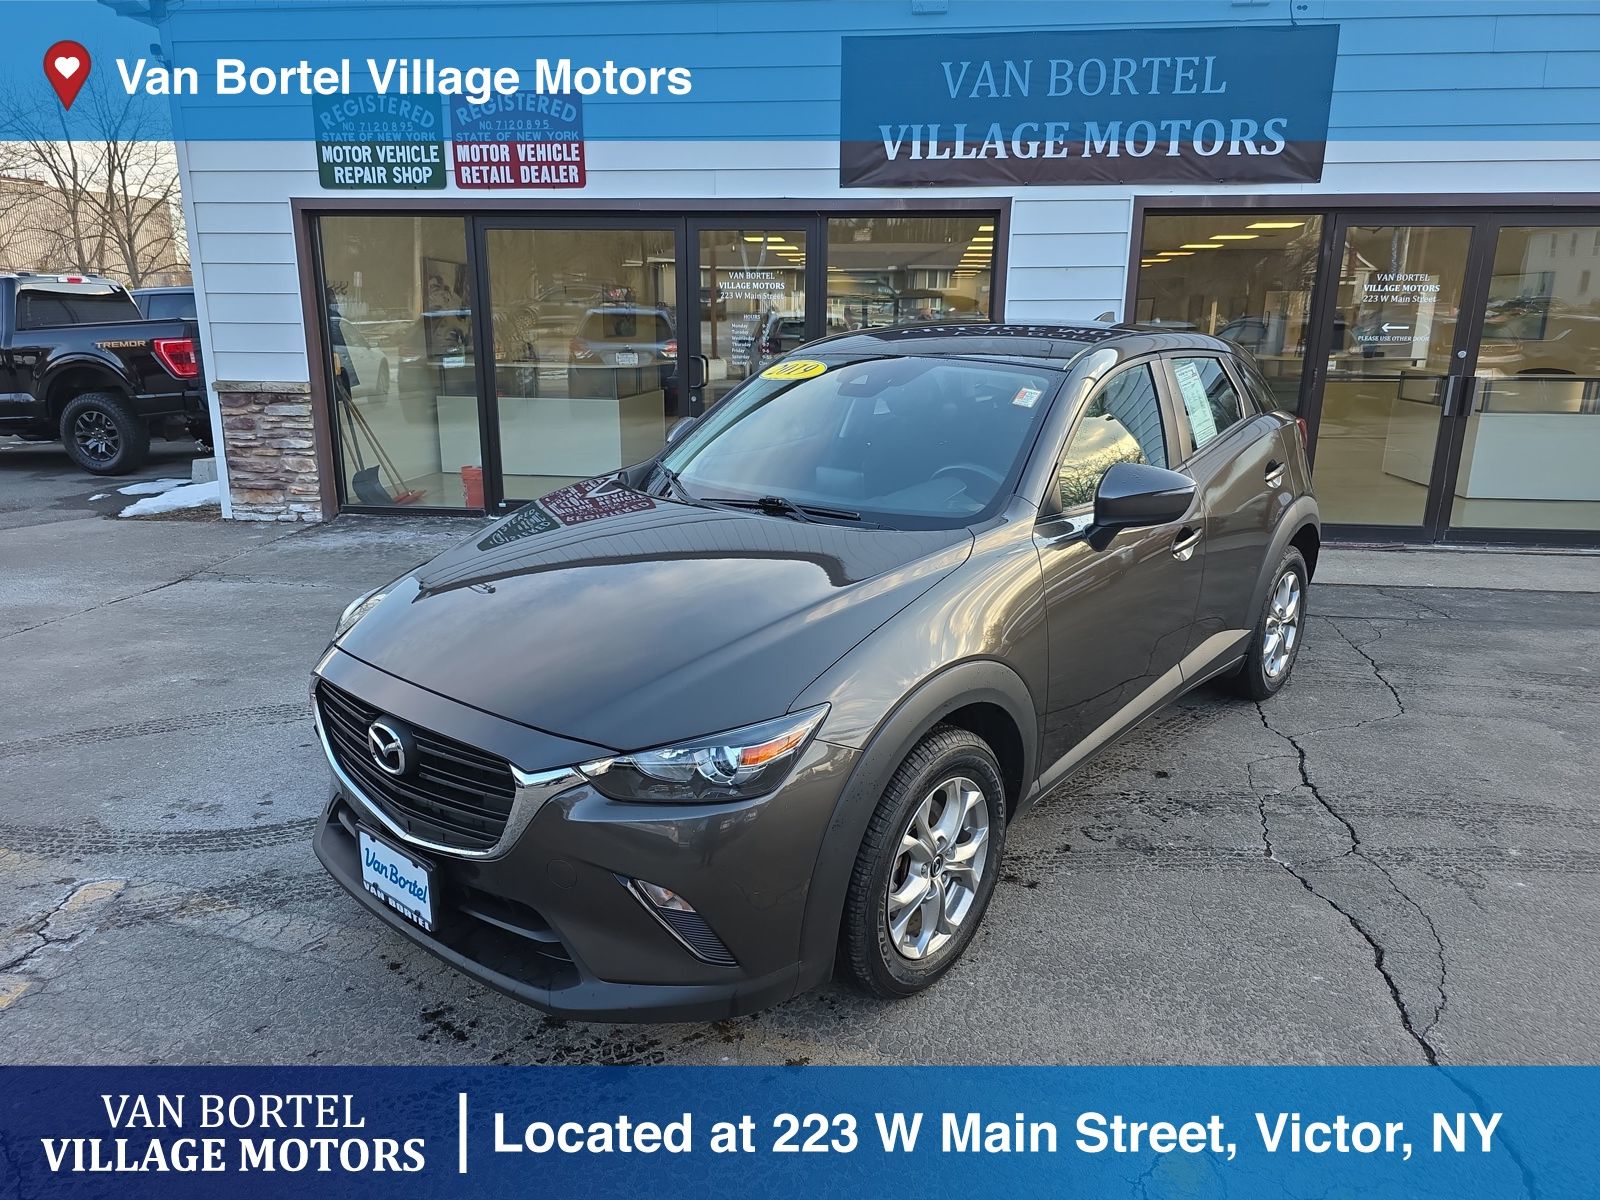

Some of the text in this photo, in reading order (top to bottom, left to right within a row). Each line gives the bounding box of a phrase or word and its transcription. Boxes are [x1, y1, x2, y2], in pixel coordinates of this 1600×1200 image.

[941, 55, 1227, 98] VAN BORTEL
[320, 94, 435, 130] REGISTERED
[456, 93, 577, 126] REGISTERED
[360, 121, 413, 132] 7120895
[496, 120, 550, 130] 7120895
[321, 132, 436, 142] STATE OF NEW YORK
[456, 131, 579, 142] STATE OF NEW YORK
[878, 117, 1288, 161] VILLAGE MOTORS
[321, 145, 440, 163] MOTOR VEHICLE
[456, 143, 580, 162] MOTOR VEHICLE
[334, 166, 432, 184] REPAIR SHOP
[461, 165, 579, 184] RETAIL DEALER
[728, 271, 775, 280] VAN BORTEL
[1377, 273, 1430, 281] VAN BORTEL
[752, 282, 785, 290] MOTORS
[1363, 284, 1440, 292] VILLAGE MOTORS
[720, 292, 784, 300] 223 W Main Street
[1412, 295, 1437, 303] Street
[96, 340, 146, 349] TREMOR
[363, 880, 433, 932] VAN BORTEL
